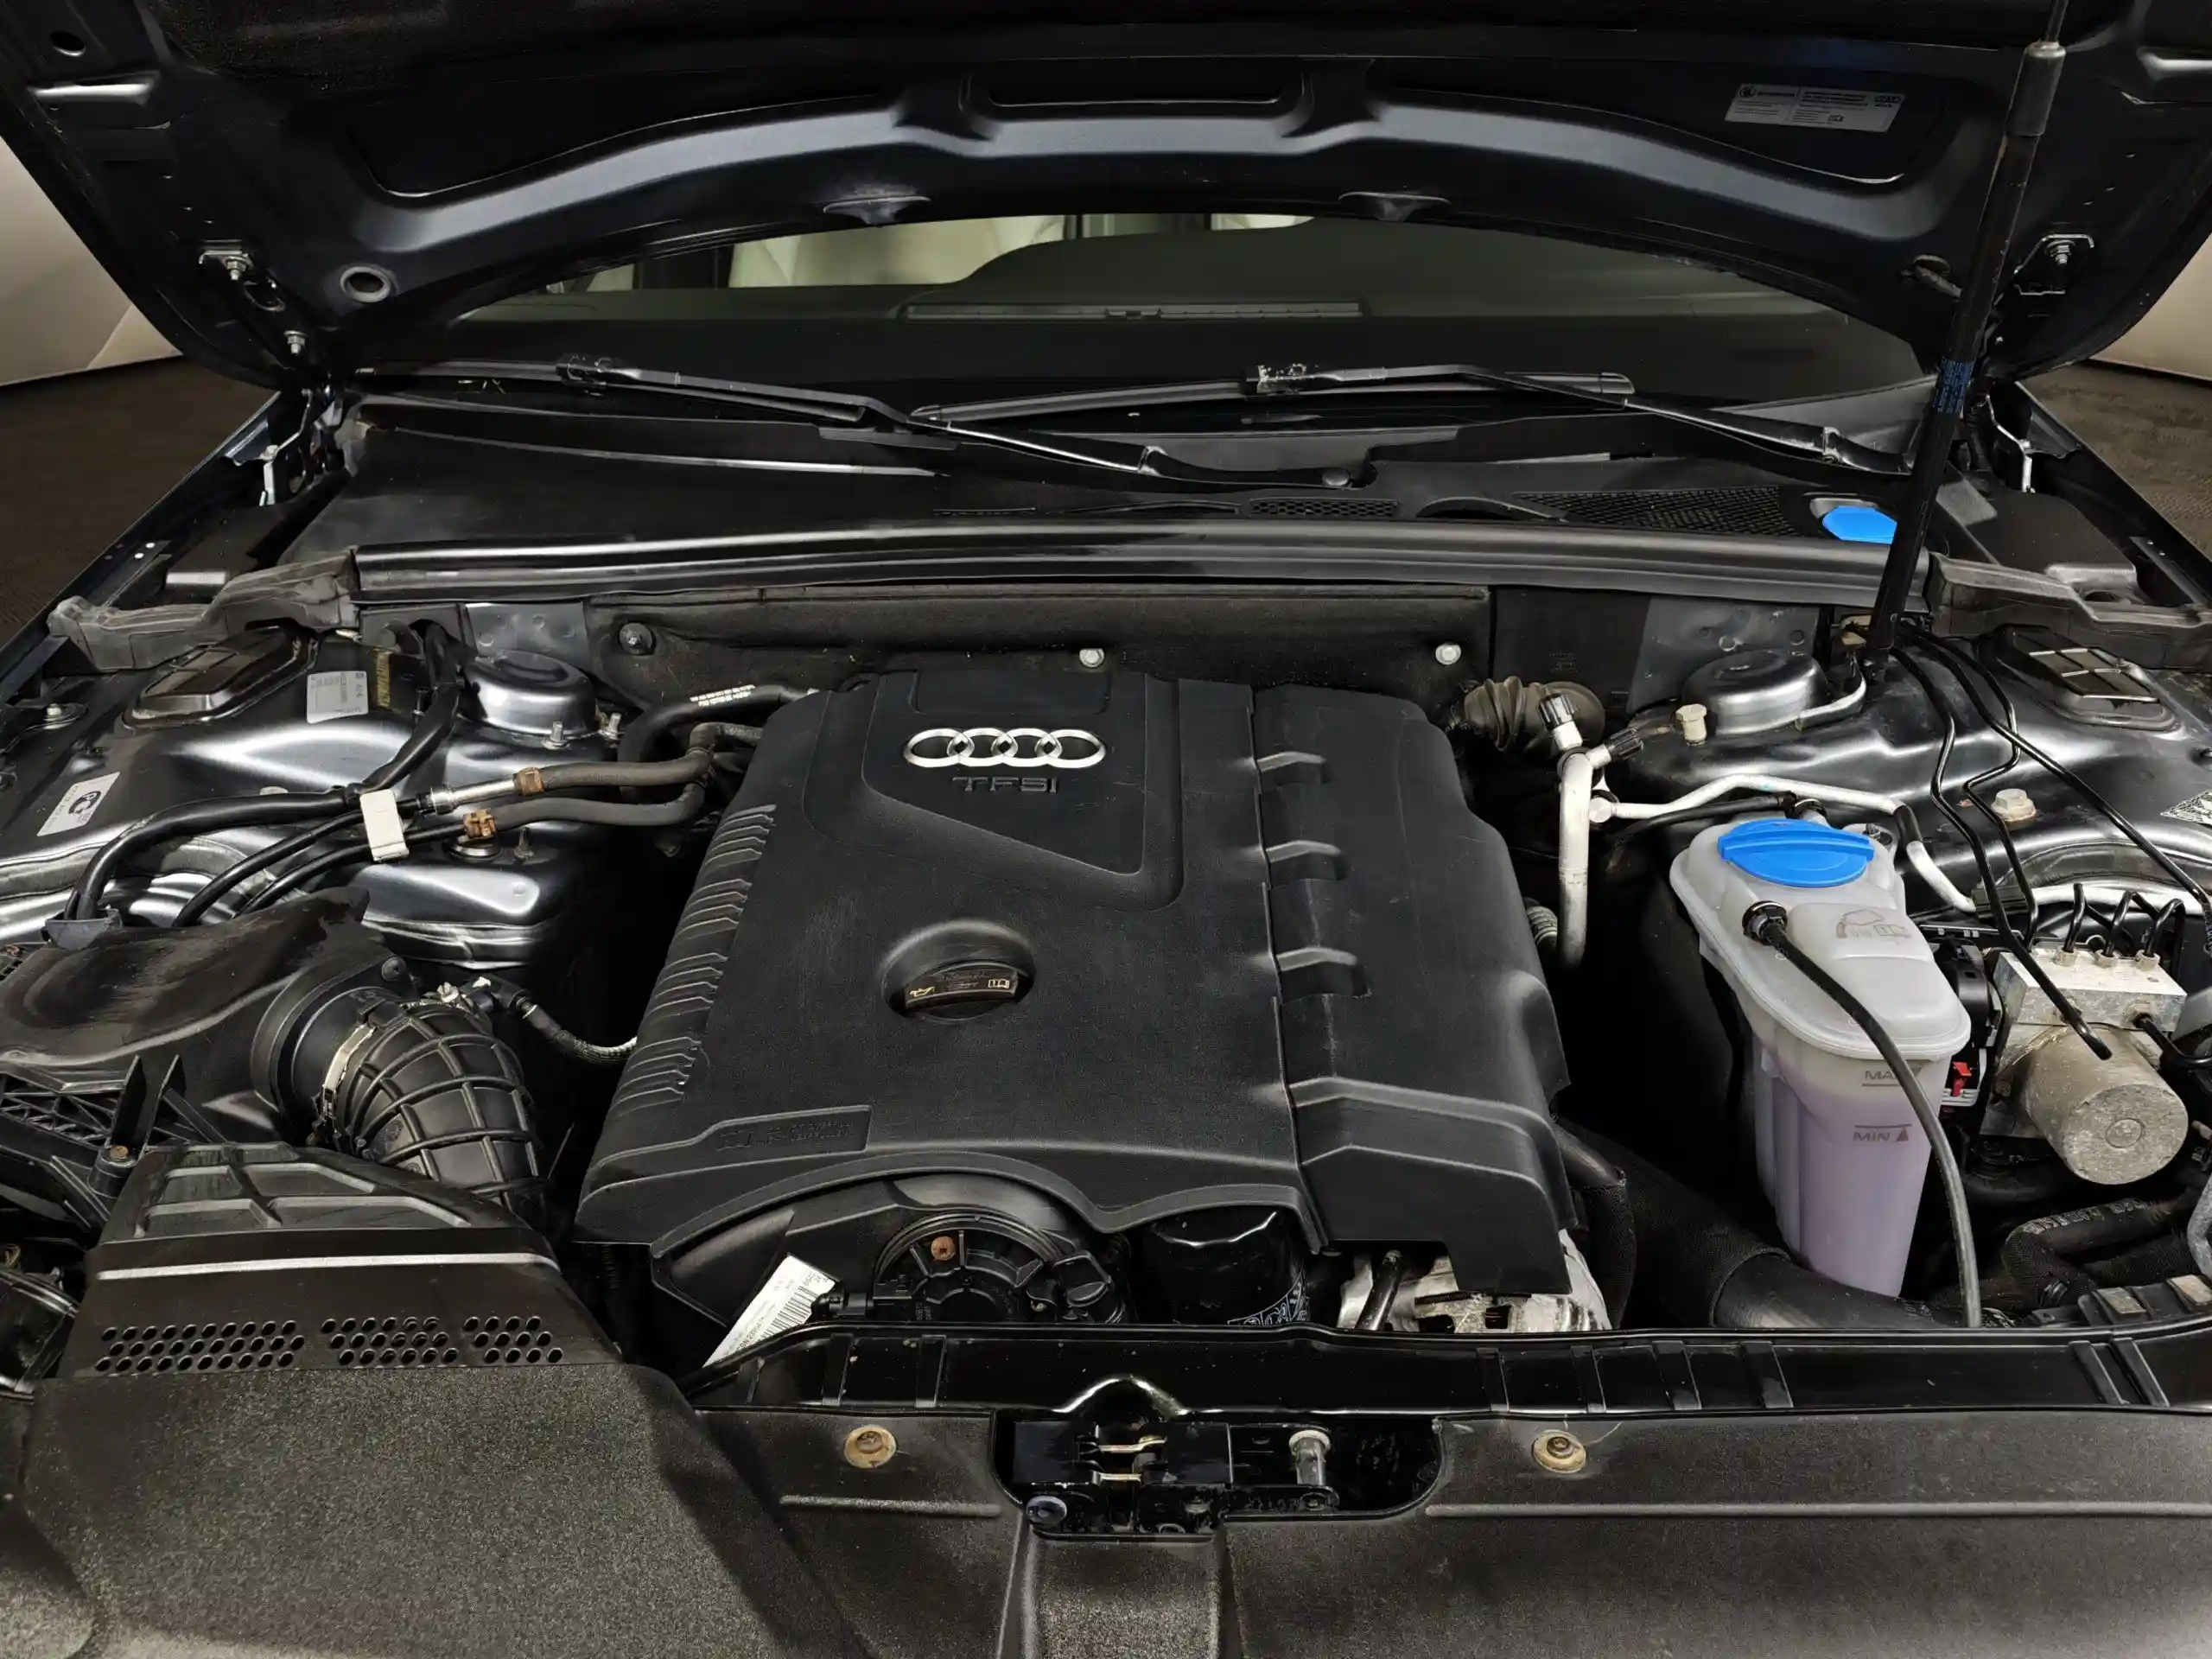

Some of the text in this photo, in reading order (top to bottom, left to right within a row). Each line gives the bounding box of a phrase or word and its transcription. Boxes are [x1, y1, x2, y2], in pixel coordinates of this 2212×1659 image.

[951, 776, 1057, 793] TFSI
[1865, 1071, 1897, 1080] MA
[1853, 1132, 1891, 1142] MIN
